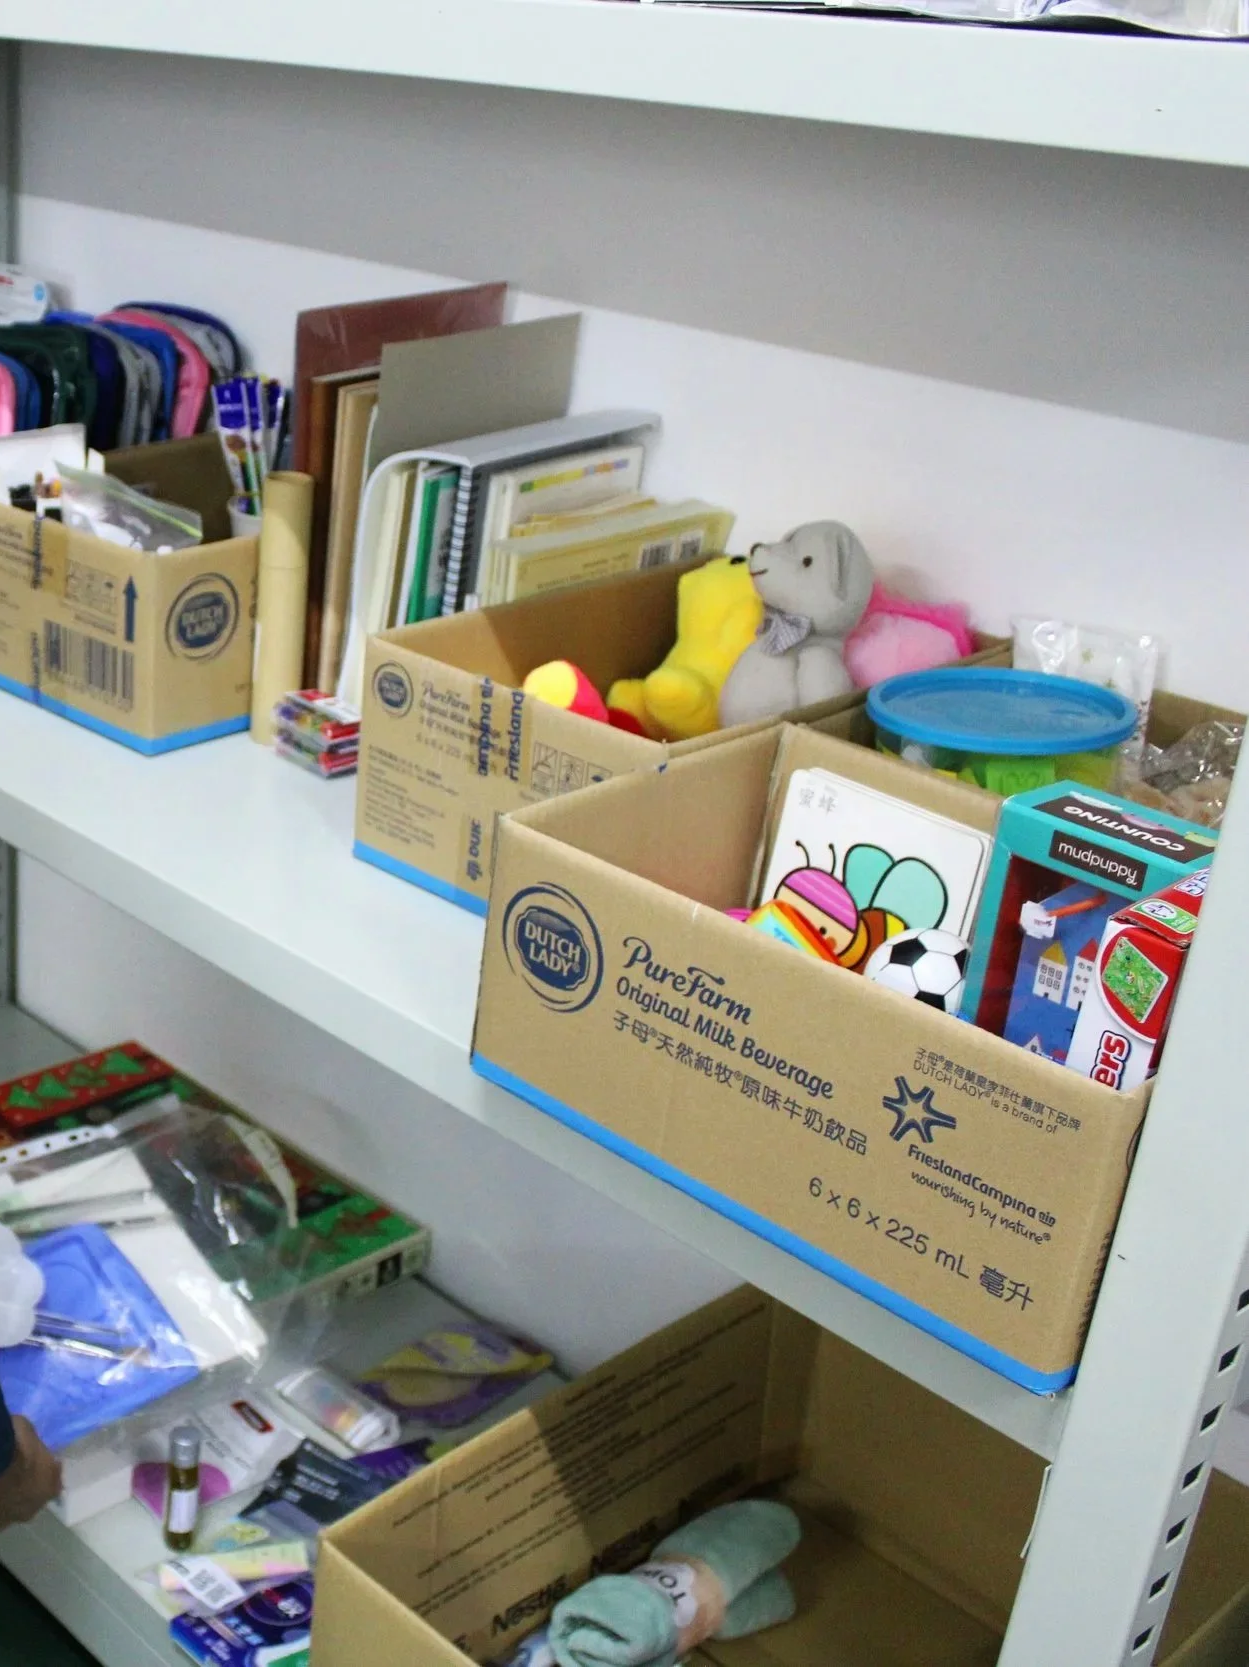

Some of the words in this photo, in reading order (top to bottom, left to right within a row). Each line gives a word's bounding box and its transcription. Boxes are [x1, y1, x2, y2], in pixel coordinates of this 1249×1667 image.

[1057, 841, 1138, 885] mudpuppy
[1062, 804, 1186, 852] COUNTING
[524, 921, 581, 963] DUTCH
[623, 936, 751, 1025] PureFarm
[616, 976, 690, 1028] Original
[693, 1014, 736, 1051] Milk
[740, 1036, 834, 1099] Beverage
[913, 1059, 952, 1086] DUTCH
[990, 1096, 1000, 1108] is
[1002, 1103, 1010, 1112] a
[1011, 1107, 1044, 1129] brand
[1045, 1124, 1059, 1134] of
[908, 1143, 1037, 1219] FrieslandCampina
[911, 1171, 975, 1217] nourishing
[980, 1201, 998, 1229] by
[809, 1176, 823, 1198] 6
[826, 1189, 841, 1210] x
[847, 1197, 862, 1219] 6
[865, 1210, 880, 1231] x
[885, 1218, 930, 1255] 225
[935, 1248, 969, 1280] mL
[978, 1263, 1034, 1311] 毫升
